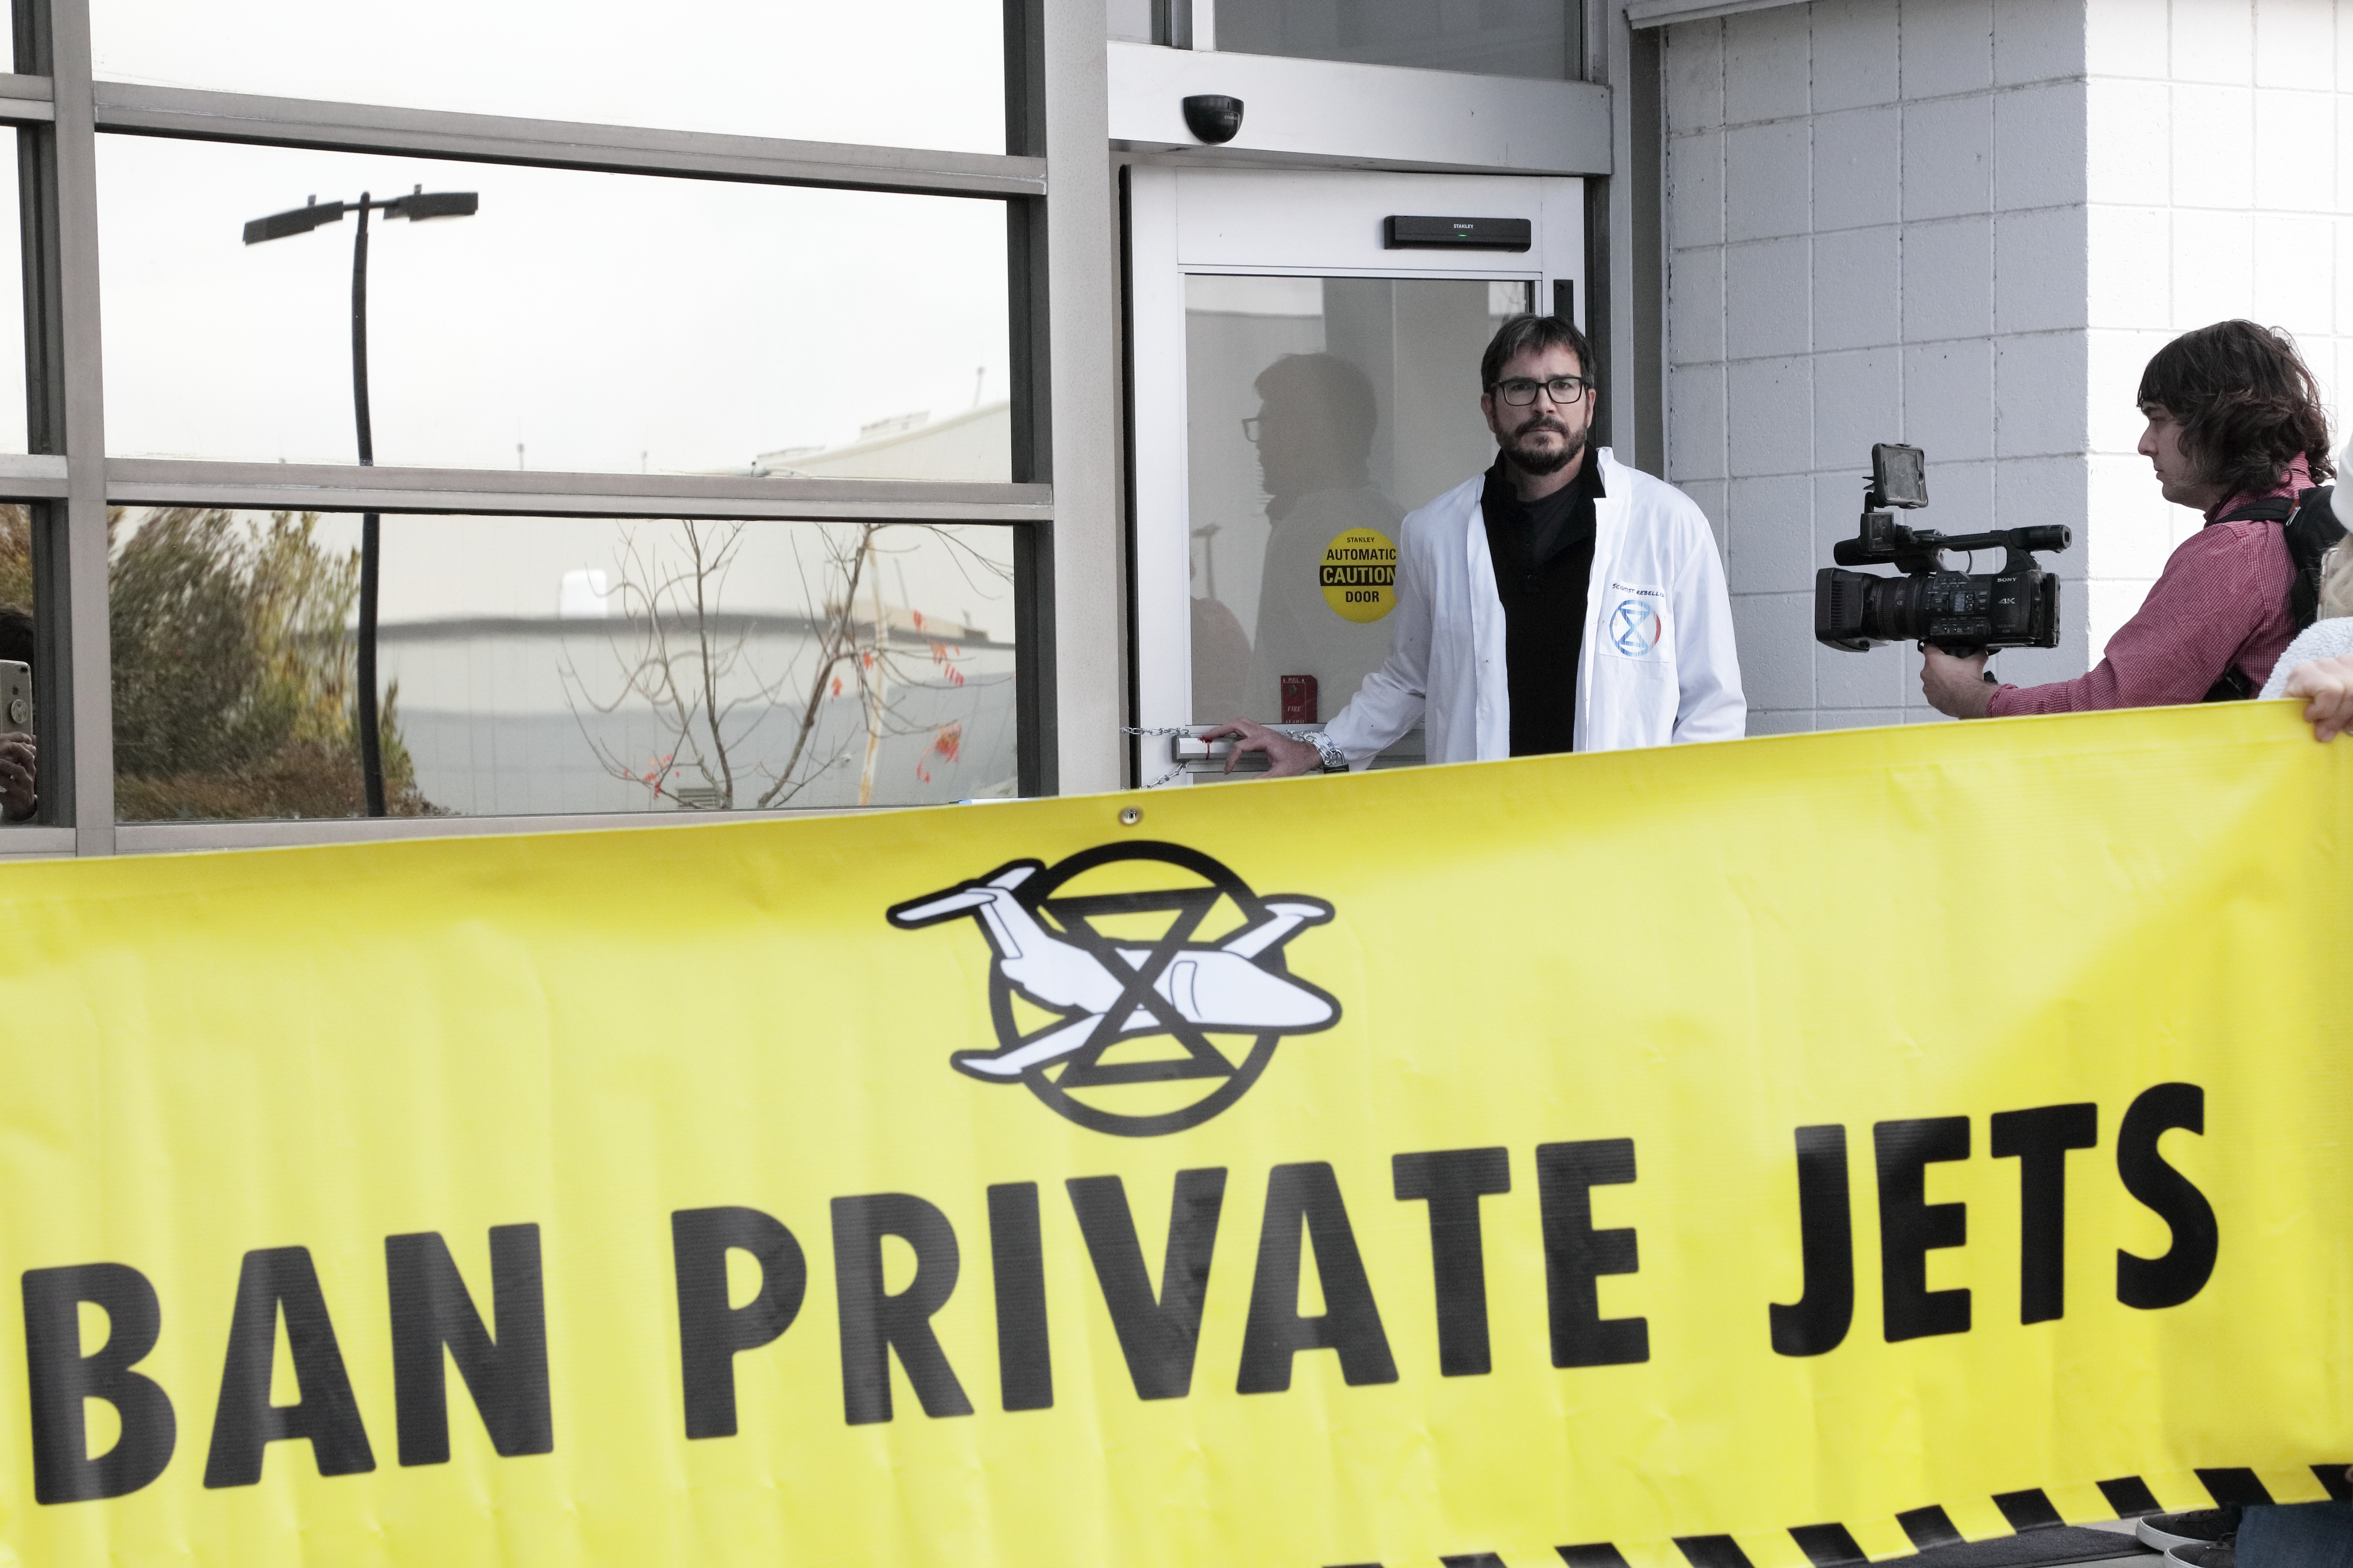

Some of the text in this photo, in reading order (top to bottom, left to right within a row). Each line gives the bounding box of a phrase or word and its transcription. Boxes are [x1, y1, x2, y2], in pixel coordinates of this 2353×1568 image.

[1326, 548, 1396, 561] AUTOMATIC
[1323, 567, 1396, 584] CAUTION
[1346, 591, 1380, 603] DOOR
[21, 1081, 2220, 1506] BAN PRIVATE JETS
